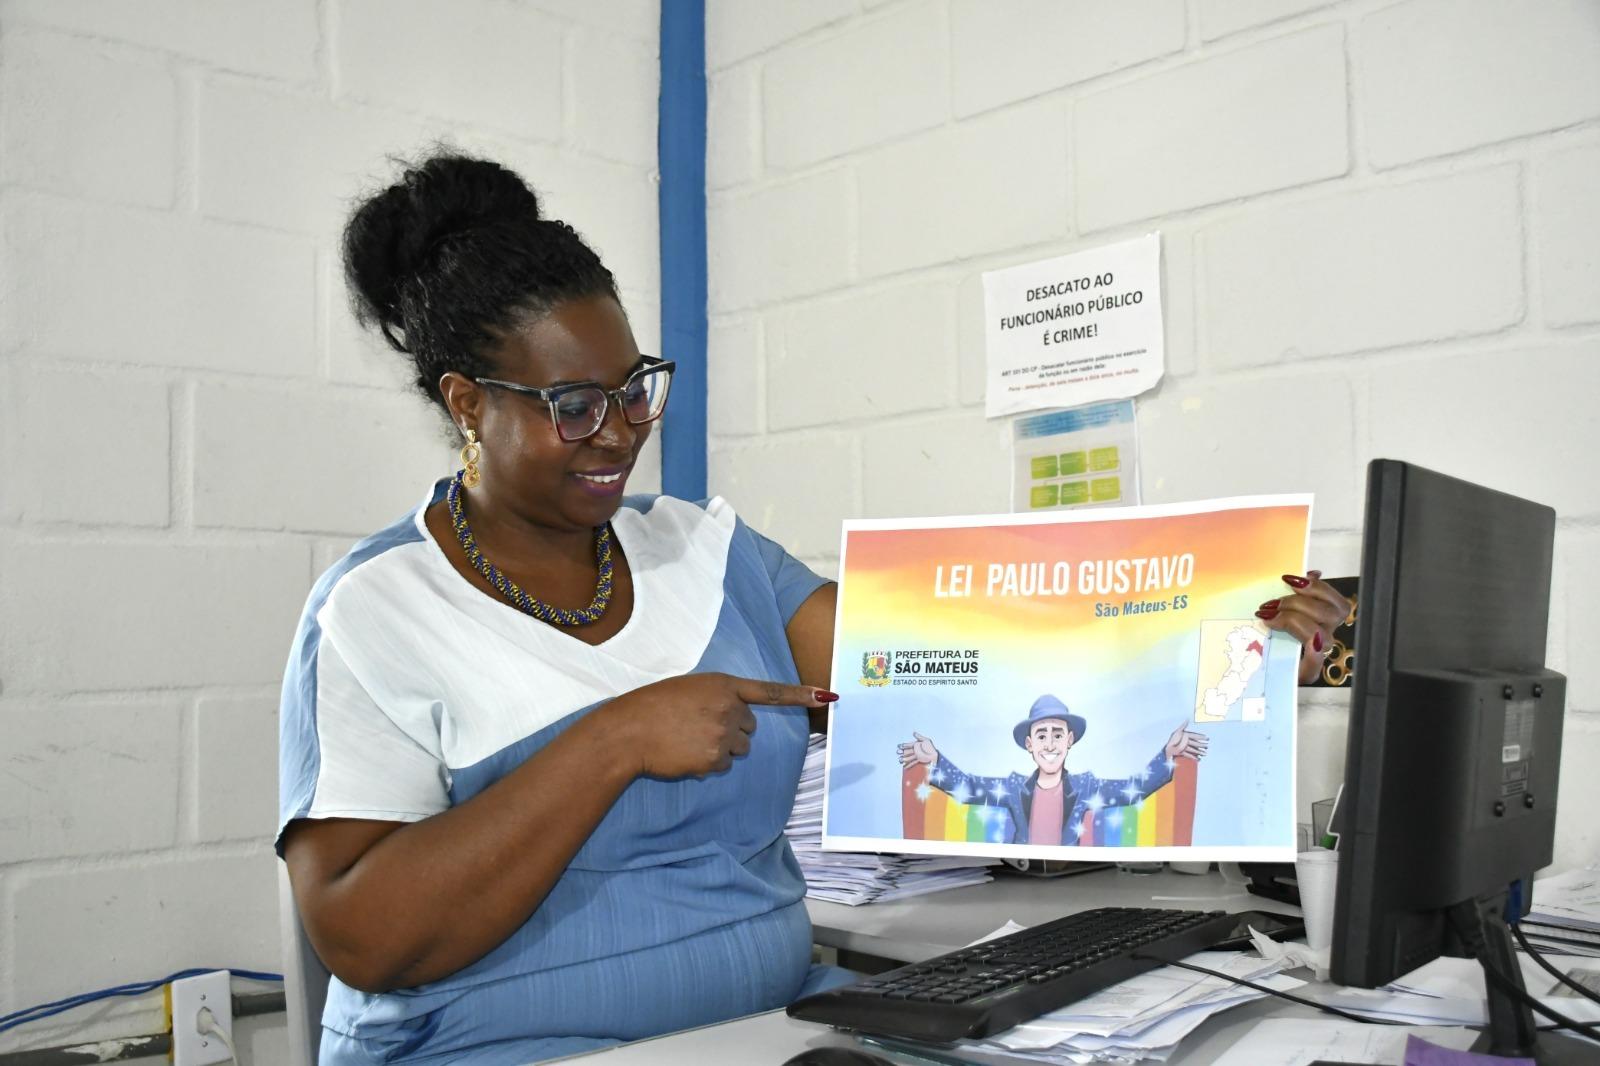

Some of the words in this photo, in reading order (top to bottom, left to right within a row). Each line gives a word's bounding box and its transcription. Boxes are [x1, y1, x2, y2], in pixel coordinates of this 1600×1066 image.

[1026, 277, 1090, 302] DESACATO
[1094, 272, 1114, 287] AO
[1000, 302, 1085, 330] FUNCIONÁRIO
[1088, 290, 1143, 313] PÚBLICO
[1043, 330, 1050, 346] É
[1053, 323, 1098, 344] CRIME!
[934, 564, 973, 598] LEI
[987, 561, 1070, 597] PAULO
[1077, 553, 1195, 595] GUSTAVO
[1095, 602, 1119, 618] São
[1122, 594, 1188, 616] Mateus-ES
[895, 650, 961, 659] PREFEITURA
[964, 650, 979, 658] DE
[894, 660, 920, 674] SÃO
[925, 661, 978, 674] MATEUS
